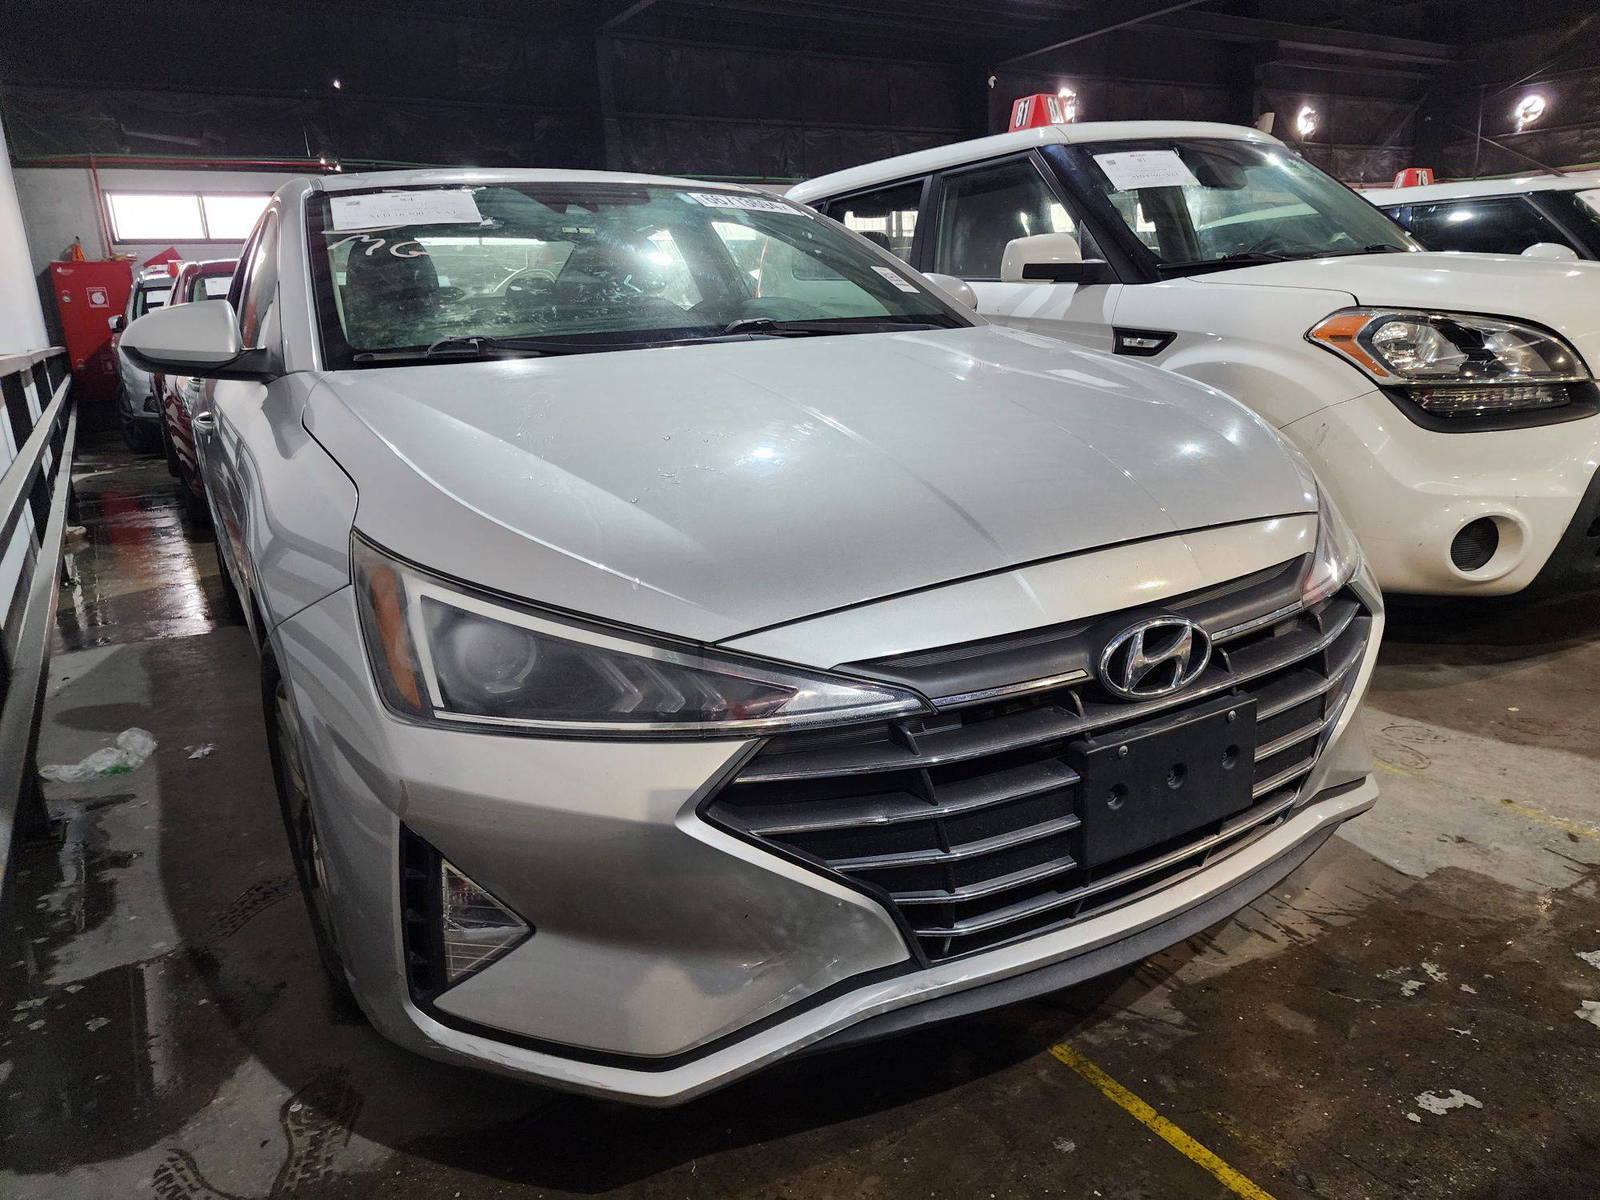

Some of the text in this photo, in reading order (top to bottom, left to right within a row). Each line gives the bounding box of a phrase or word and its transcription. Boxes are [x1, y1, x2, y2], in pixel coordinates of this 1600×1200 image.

[1014, 99, 1030, 128] 81
[1047, 96, 1065, 124] 81
[1416, 169, 1429, 186] 78
